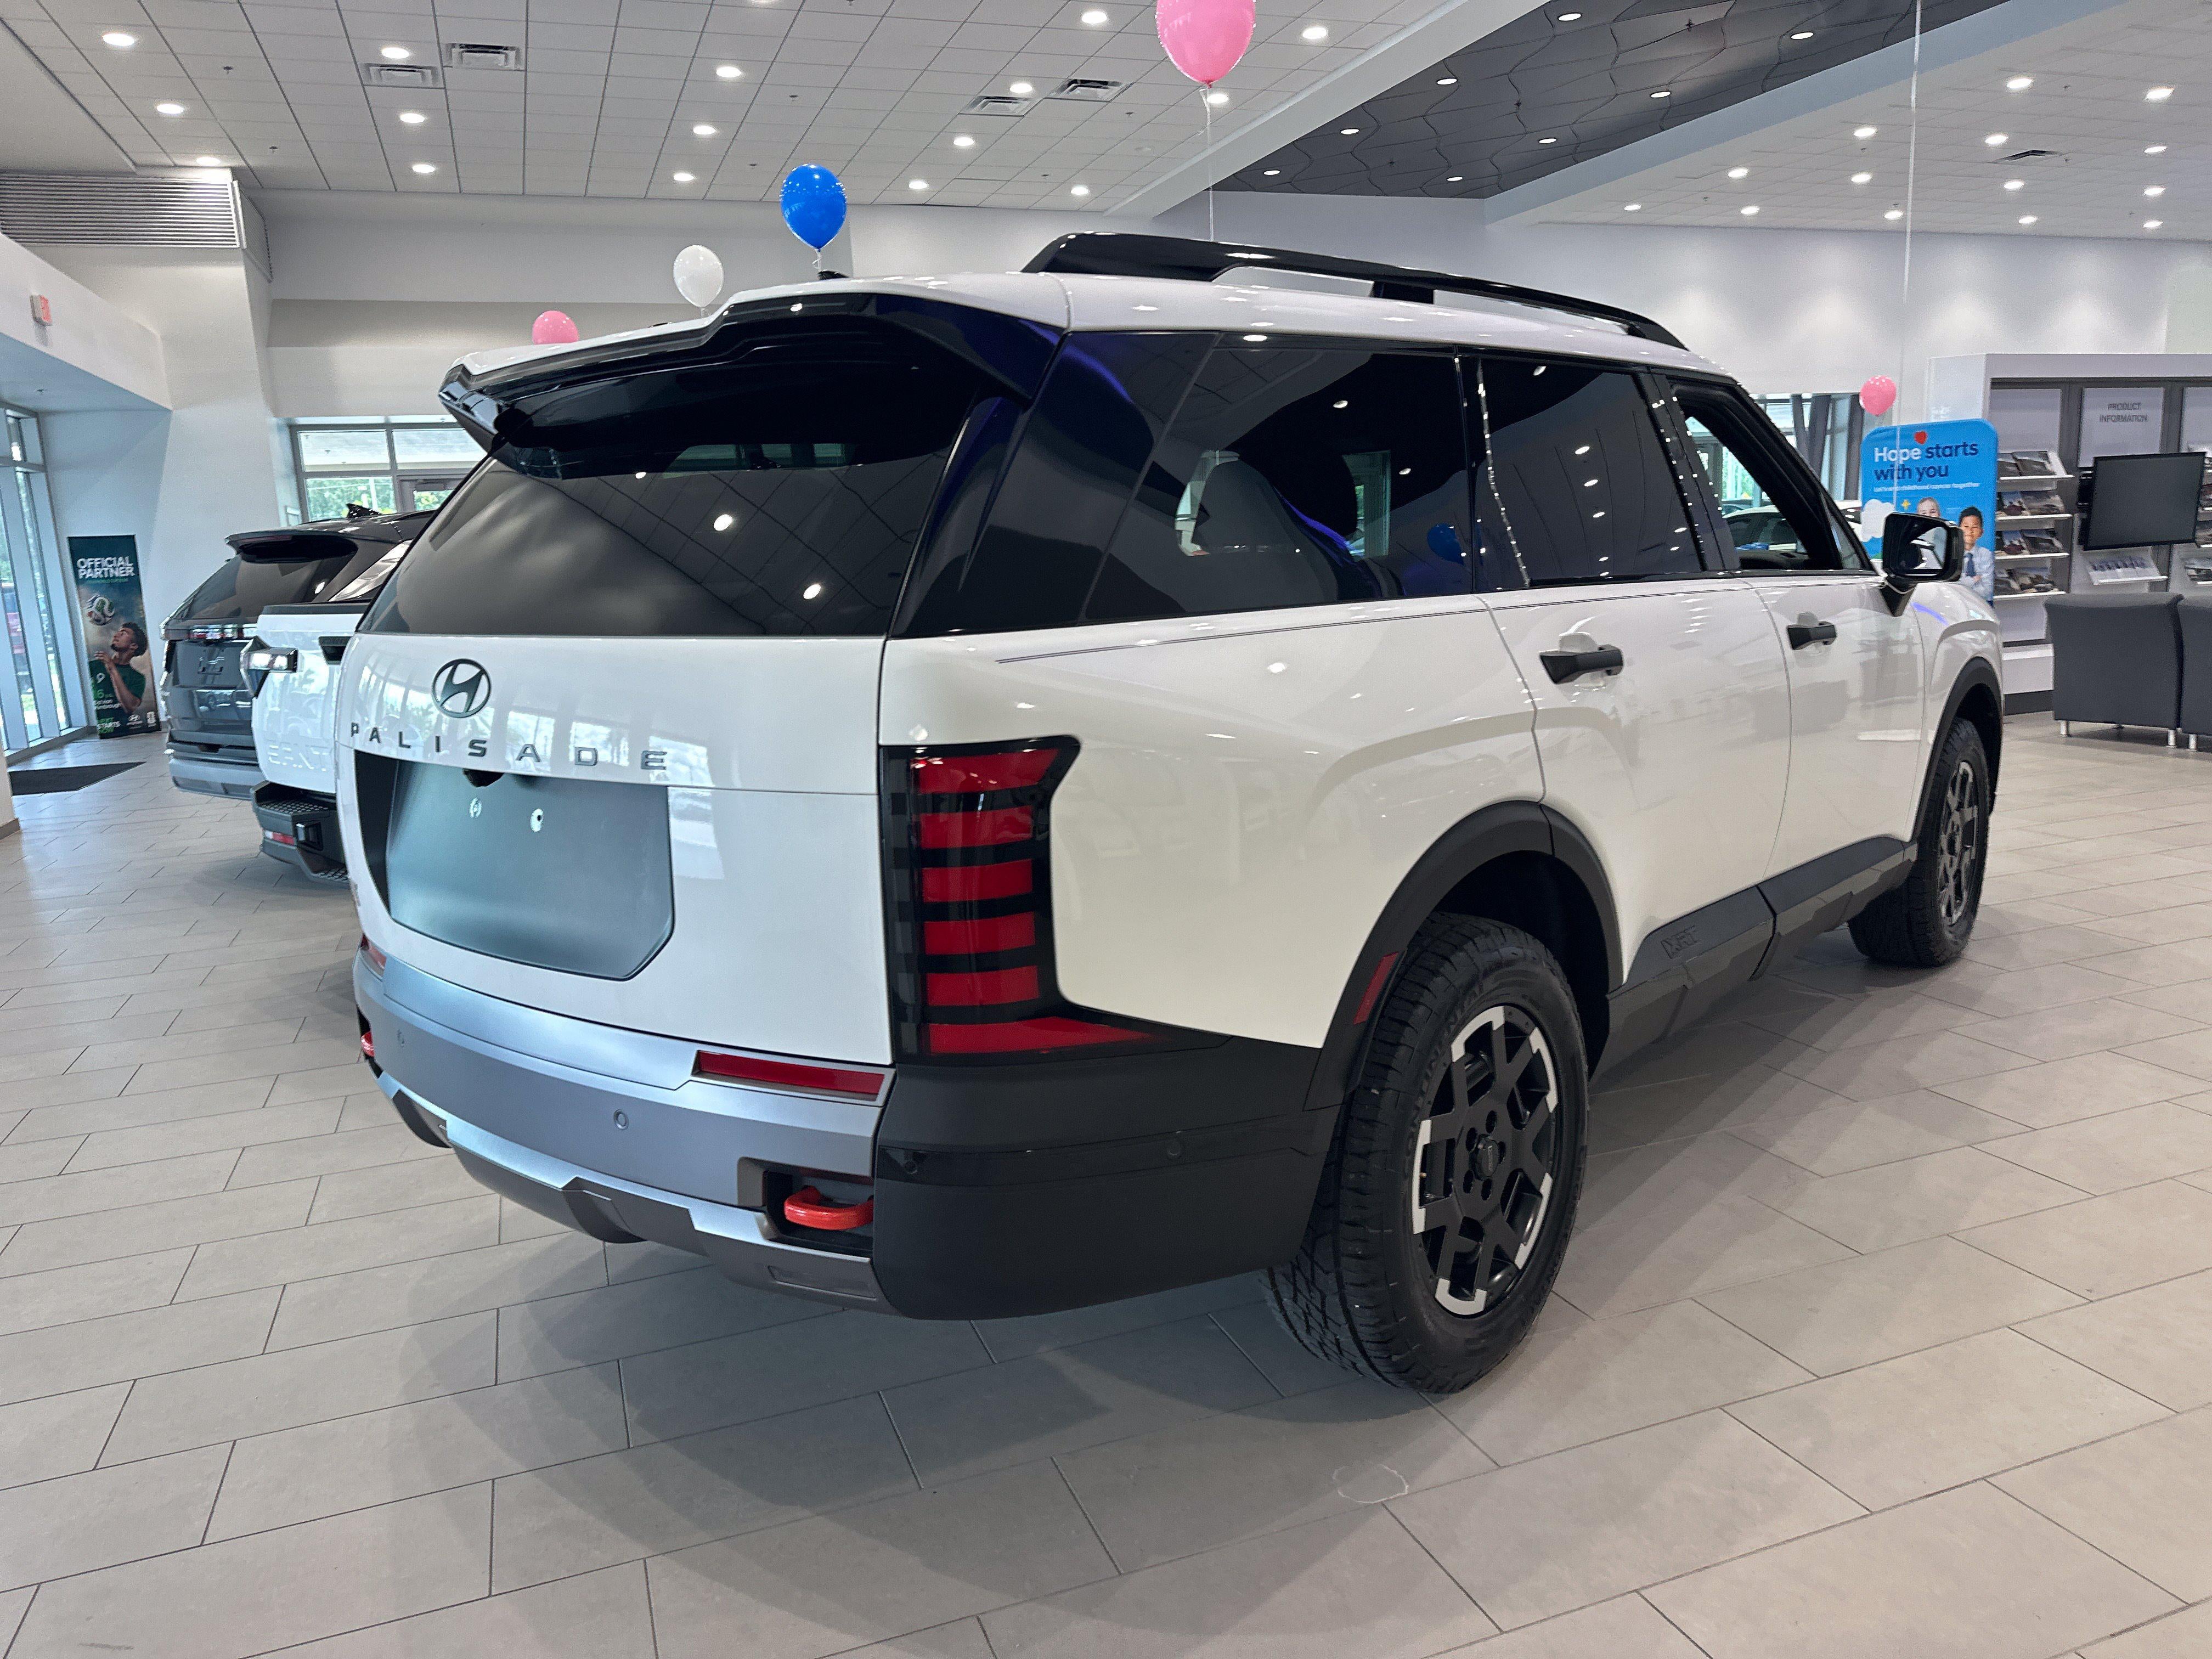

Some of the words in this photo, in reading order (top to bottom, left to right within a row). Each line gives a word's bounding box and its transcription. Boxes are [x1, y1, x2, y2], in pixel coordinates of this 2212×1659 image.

[2107, 402, 2141, 410] PRODUCT
[1874, 447, 1922, 464] Hope
[1925, 441, 1979, 459] starts
[1874, 464, 1912, 481] with
[1915, 465, 1949, 482] you
[77, 556, 133, 569] OFFICIAL
[78, 566, 136, 579] PARTNER
[351, 722, 667, 770] PALISADE
